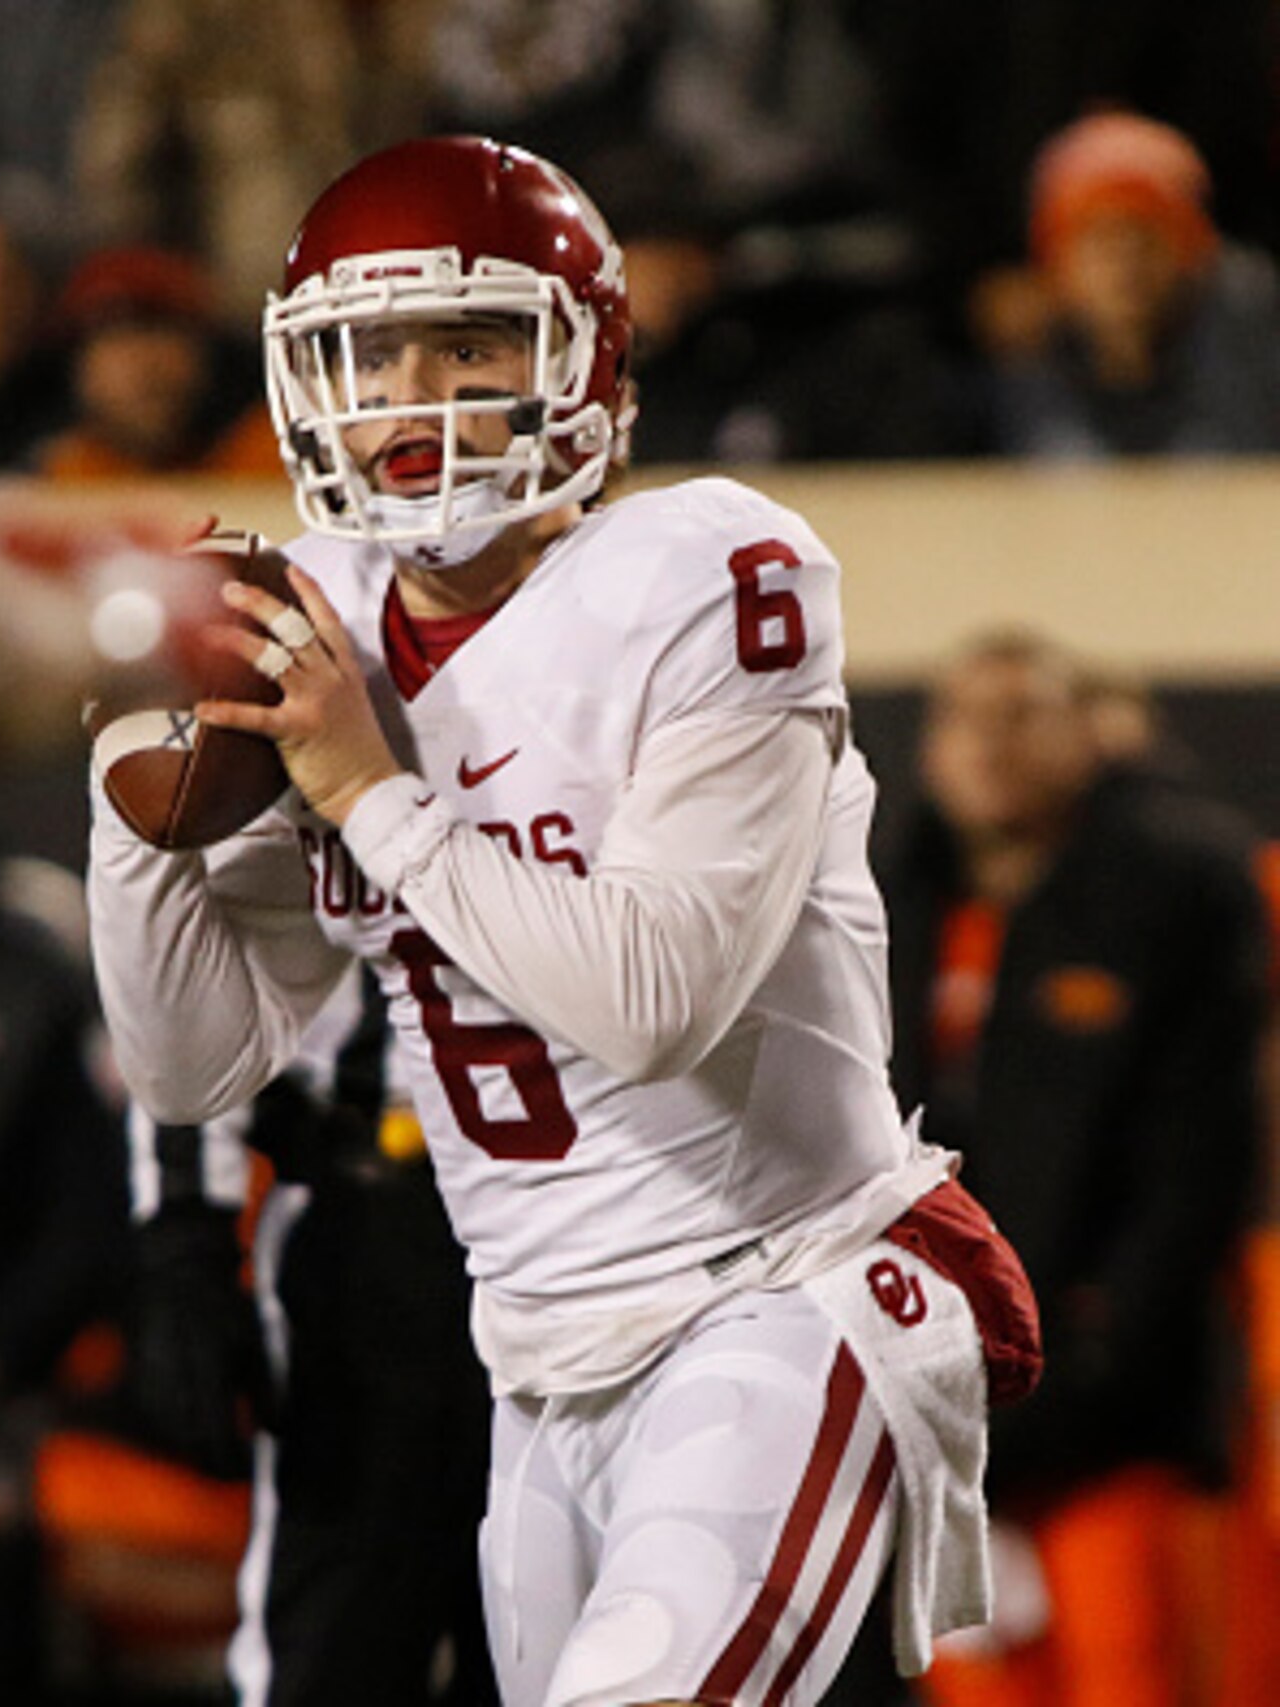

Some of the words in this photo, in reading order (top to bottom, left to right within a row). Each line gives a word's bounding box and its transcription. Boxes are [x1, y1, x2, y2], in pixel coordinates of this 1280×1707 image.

[727, 538, 807, 674] 6
[388, 927, 578, 1161] 6
[865, 1257, 928, 1329] OU
